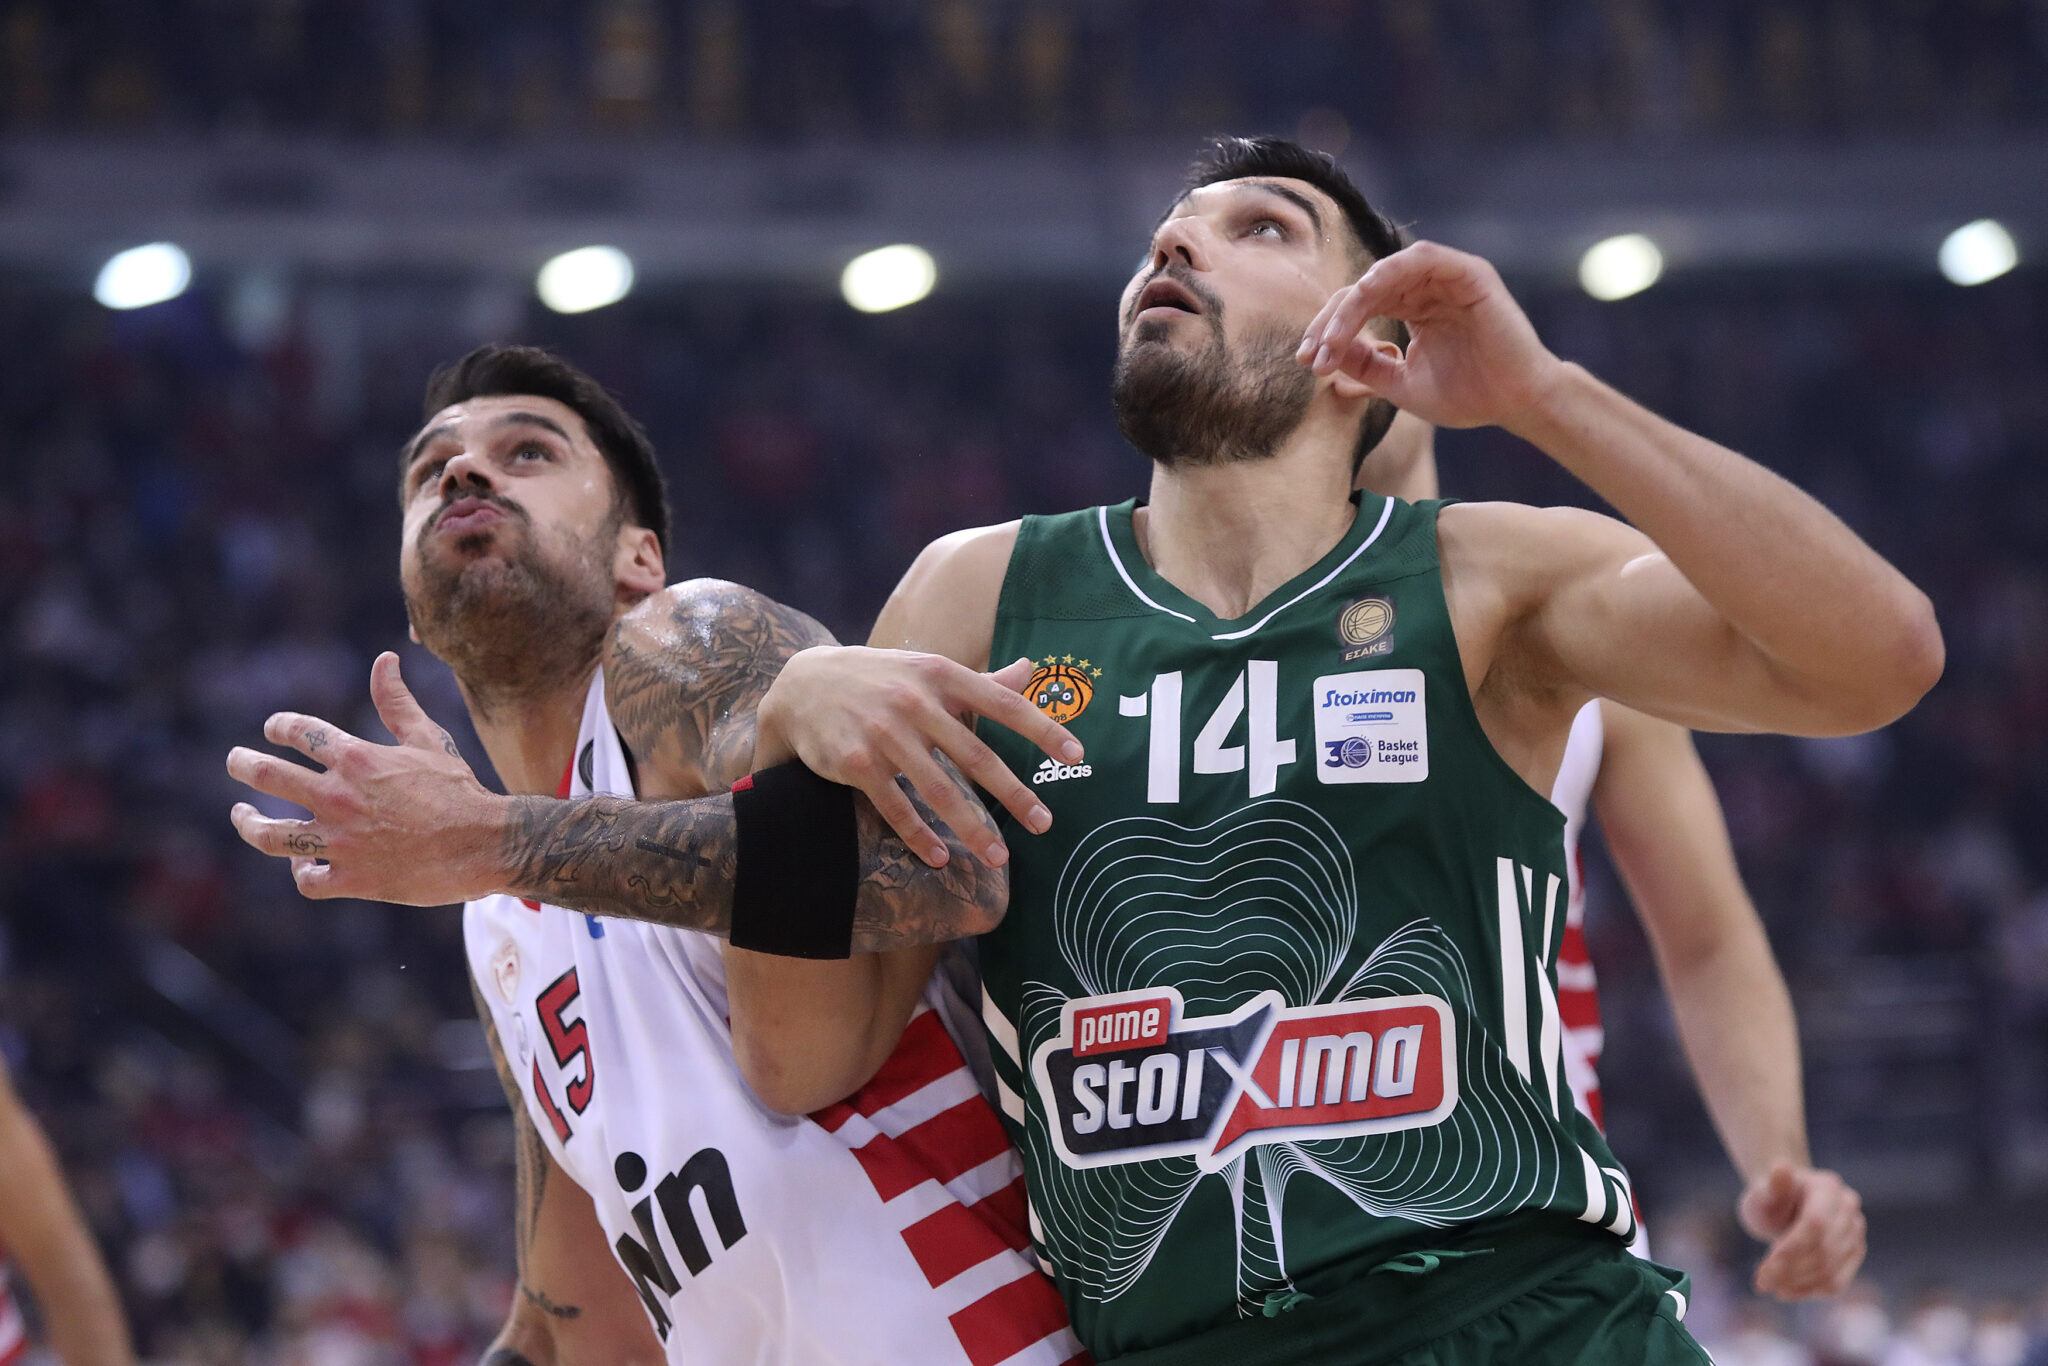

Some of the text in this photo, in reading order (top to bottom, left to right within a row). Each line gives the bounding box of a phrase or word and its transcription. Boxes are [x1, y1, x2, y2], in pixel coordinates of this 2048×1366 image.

[1322, 688, 1416, 708] Stoiximan
[1119, 659, 1296, 803] 14
[1378, 739, 1419, 751] Basket
[1378, 752, 1419, 765] League
[1032, 764, 1092, 784] adidas
[1080, 1007, 1160, 1051] pame
[533, 966, 595, 1147] 15
